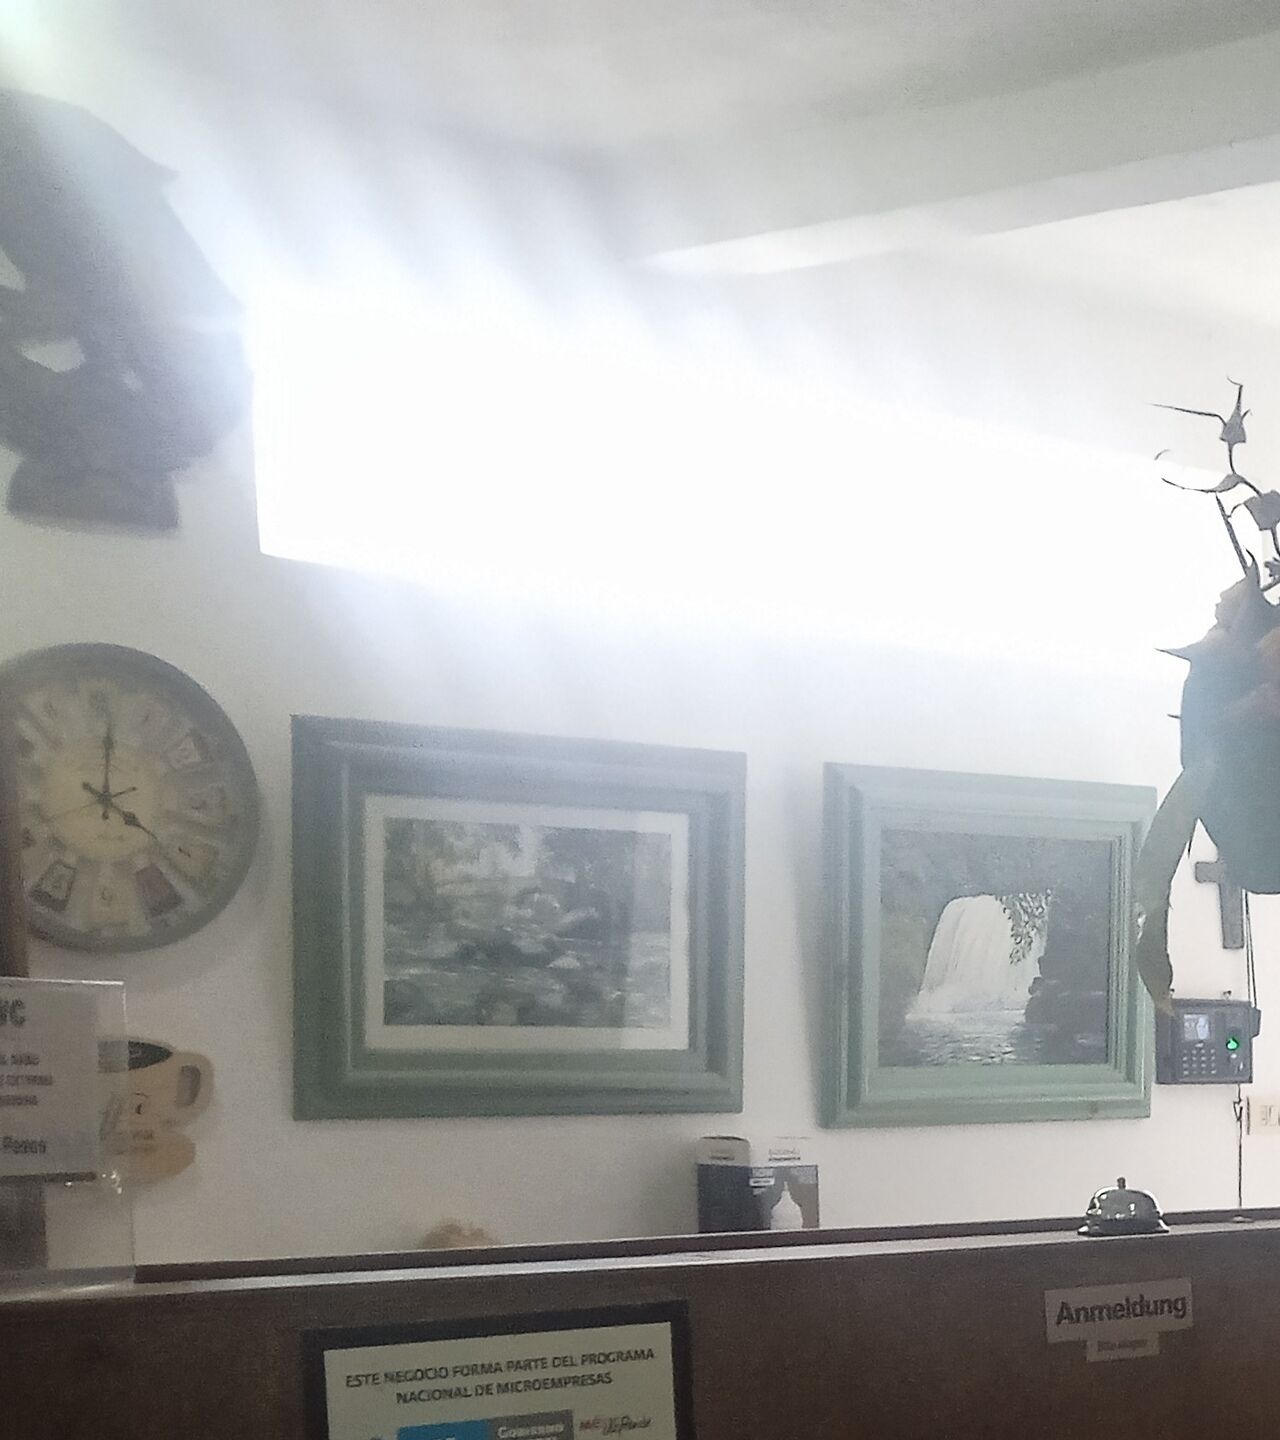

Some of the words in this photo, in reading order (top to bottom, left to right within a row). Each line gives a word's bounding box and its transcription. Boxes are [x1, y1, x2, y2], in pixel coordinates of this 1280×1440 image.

[1056, 1294, 1187, 1326] Anmeldung
[346, 1372, 381, 1388] ESTE
[384, 1366, 449, 1384] NEGOCIO
[452, 1360, 503, 1379] FORMA
[506, 1356, 549, 1375] PARTE
[552, 1354, 578, 1370] DEL
[581, 1347, 655, 1367] PROGRAMA
[396, 1385, 472, 1405] NACIONAL
[474, 1382, 494, 1398] DE
[496, 1371, 612, 1395] MICROEMPRESAS
